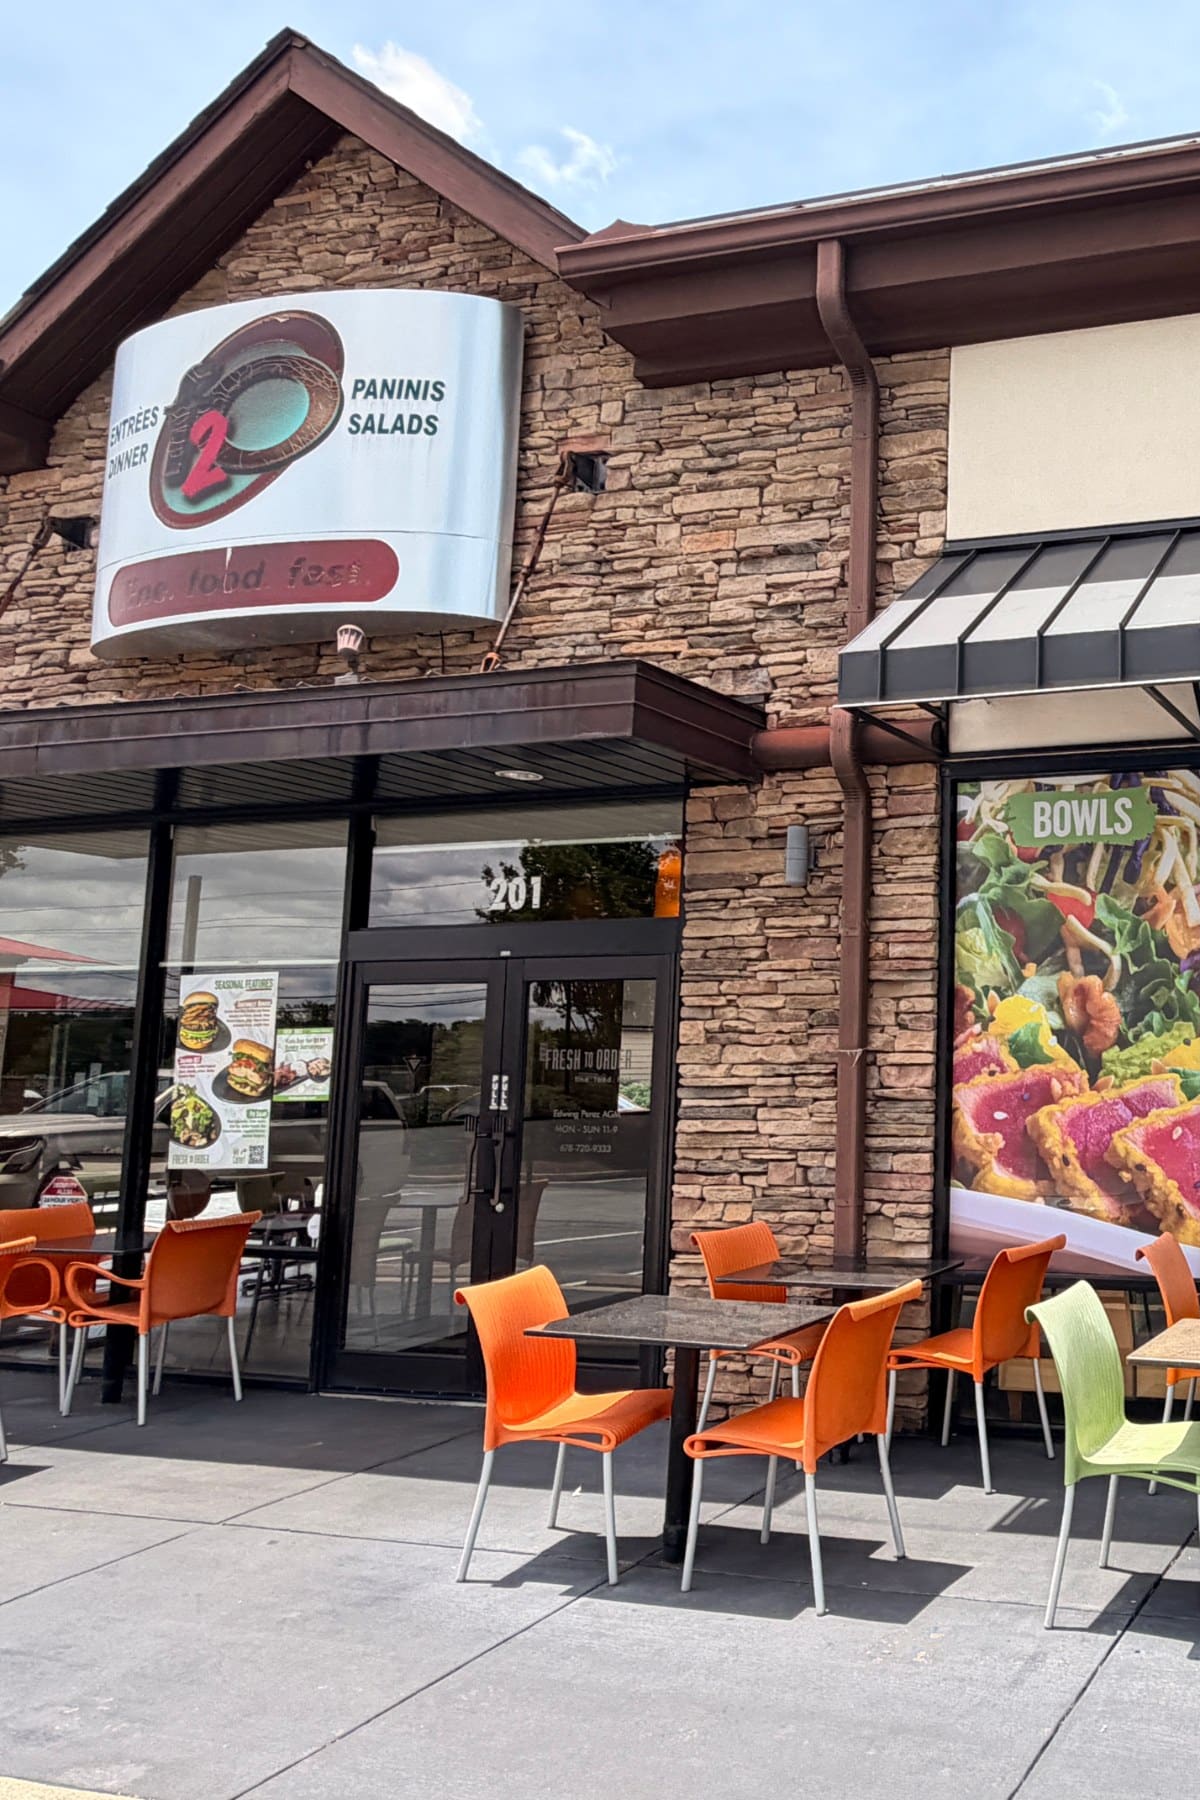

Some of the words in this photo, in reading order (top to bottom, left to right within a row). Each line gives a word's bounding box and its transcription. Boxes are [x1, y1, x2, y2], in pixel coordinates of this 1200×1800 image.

[351, 378, 446, 402] PANINIS
[347, 413, 439, 436] SALADS
[108, 443, 149, 479] DINNER
[1033, 796, 1133, 839] BOWLS
[490, 876, 541, 910] 201
[545, 1048, 581, 1070] FRESH
[555, 1125, 576, 1133] MON
[583, 1125, 600, 1133] SUN
